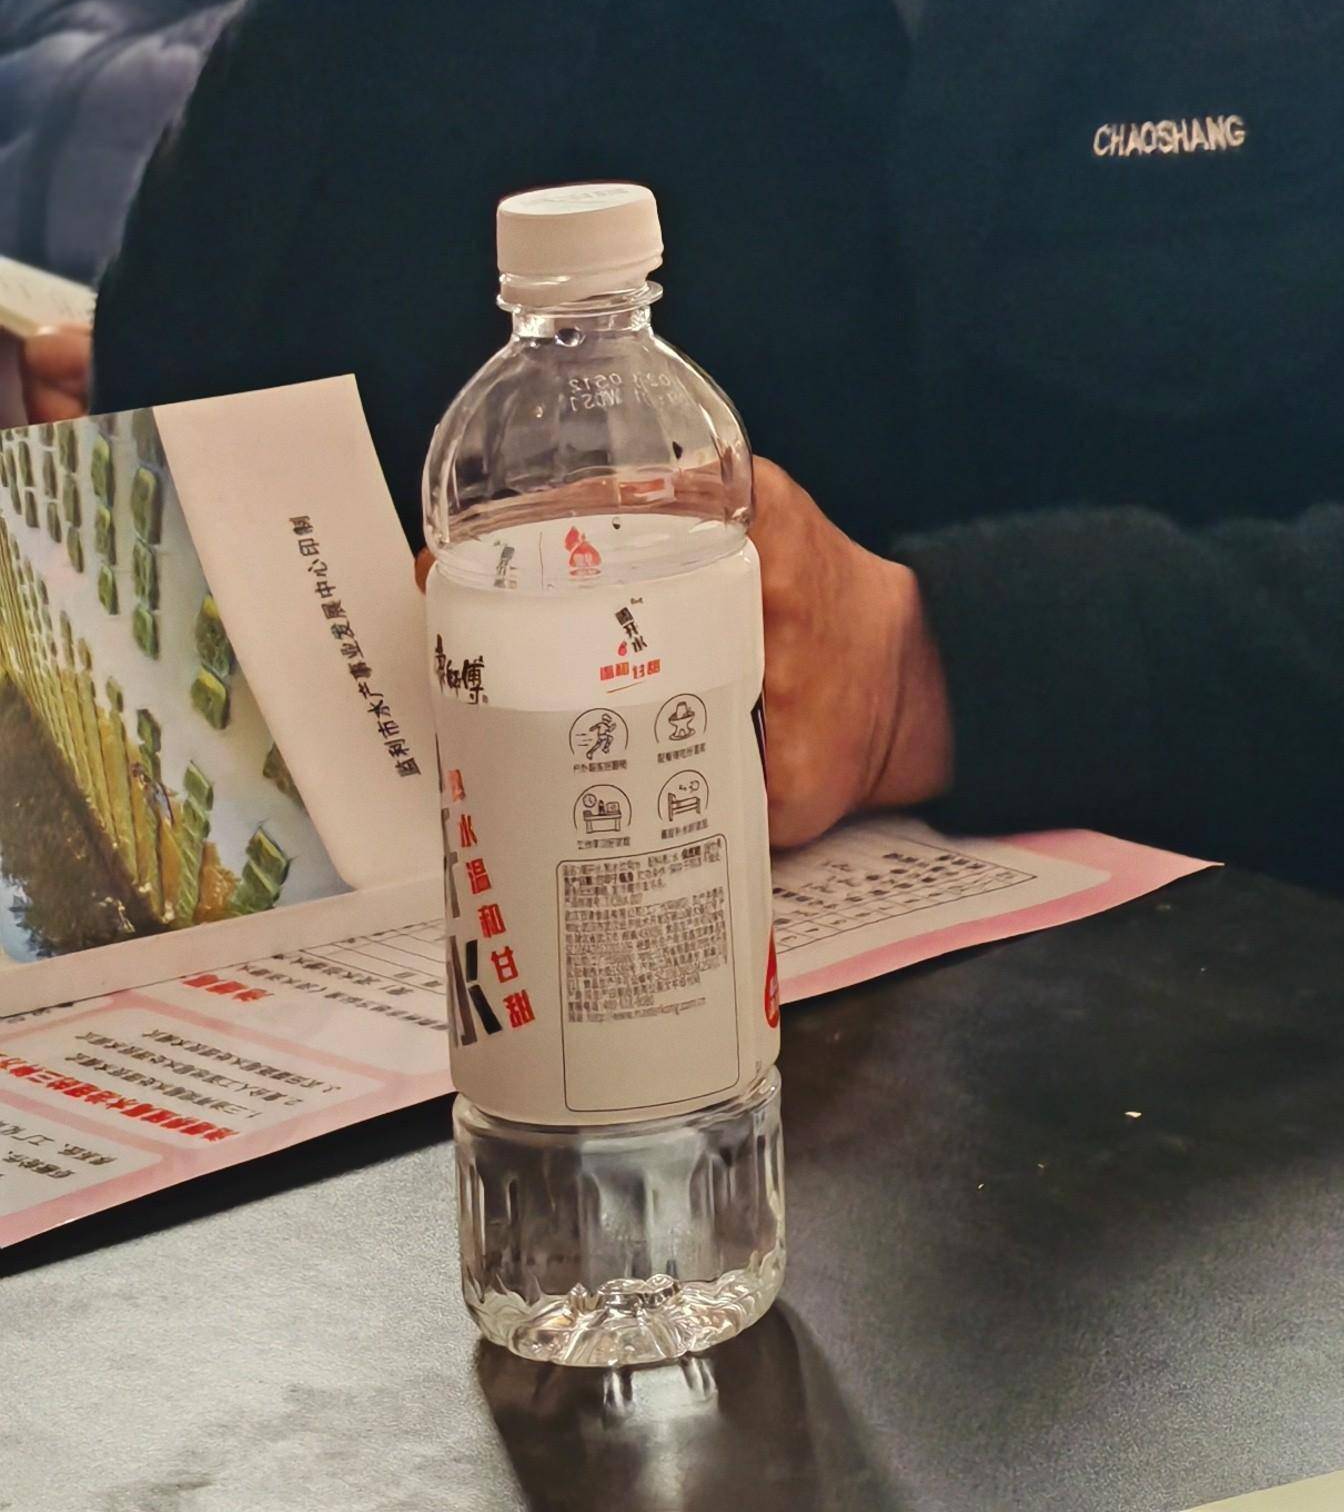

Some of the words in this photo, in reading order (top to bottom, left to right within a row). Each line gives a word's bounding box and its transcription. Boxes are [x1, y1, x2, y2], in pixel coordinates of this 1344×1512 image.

[1092, 114, 1247, 157] CHAOSHANG
[289, 515, 421, 778] 监利市水产事业发展中心印制
